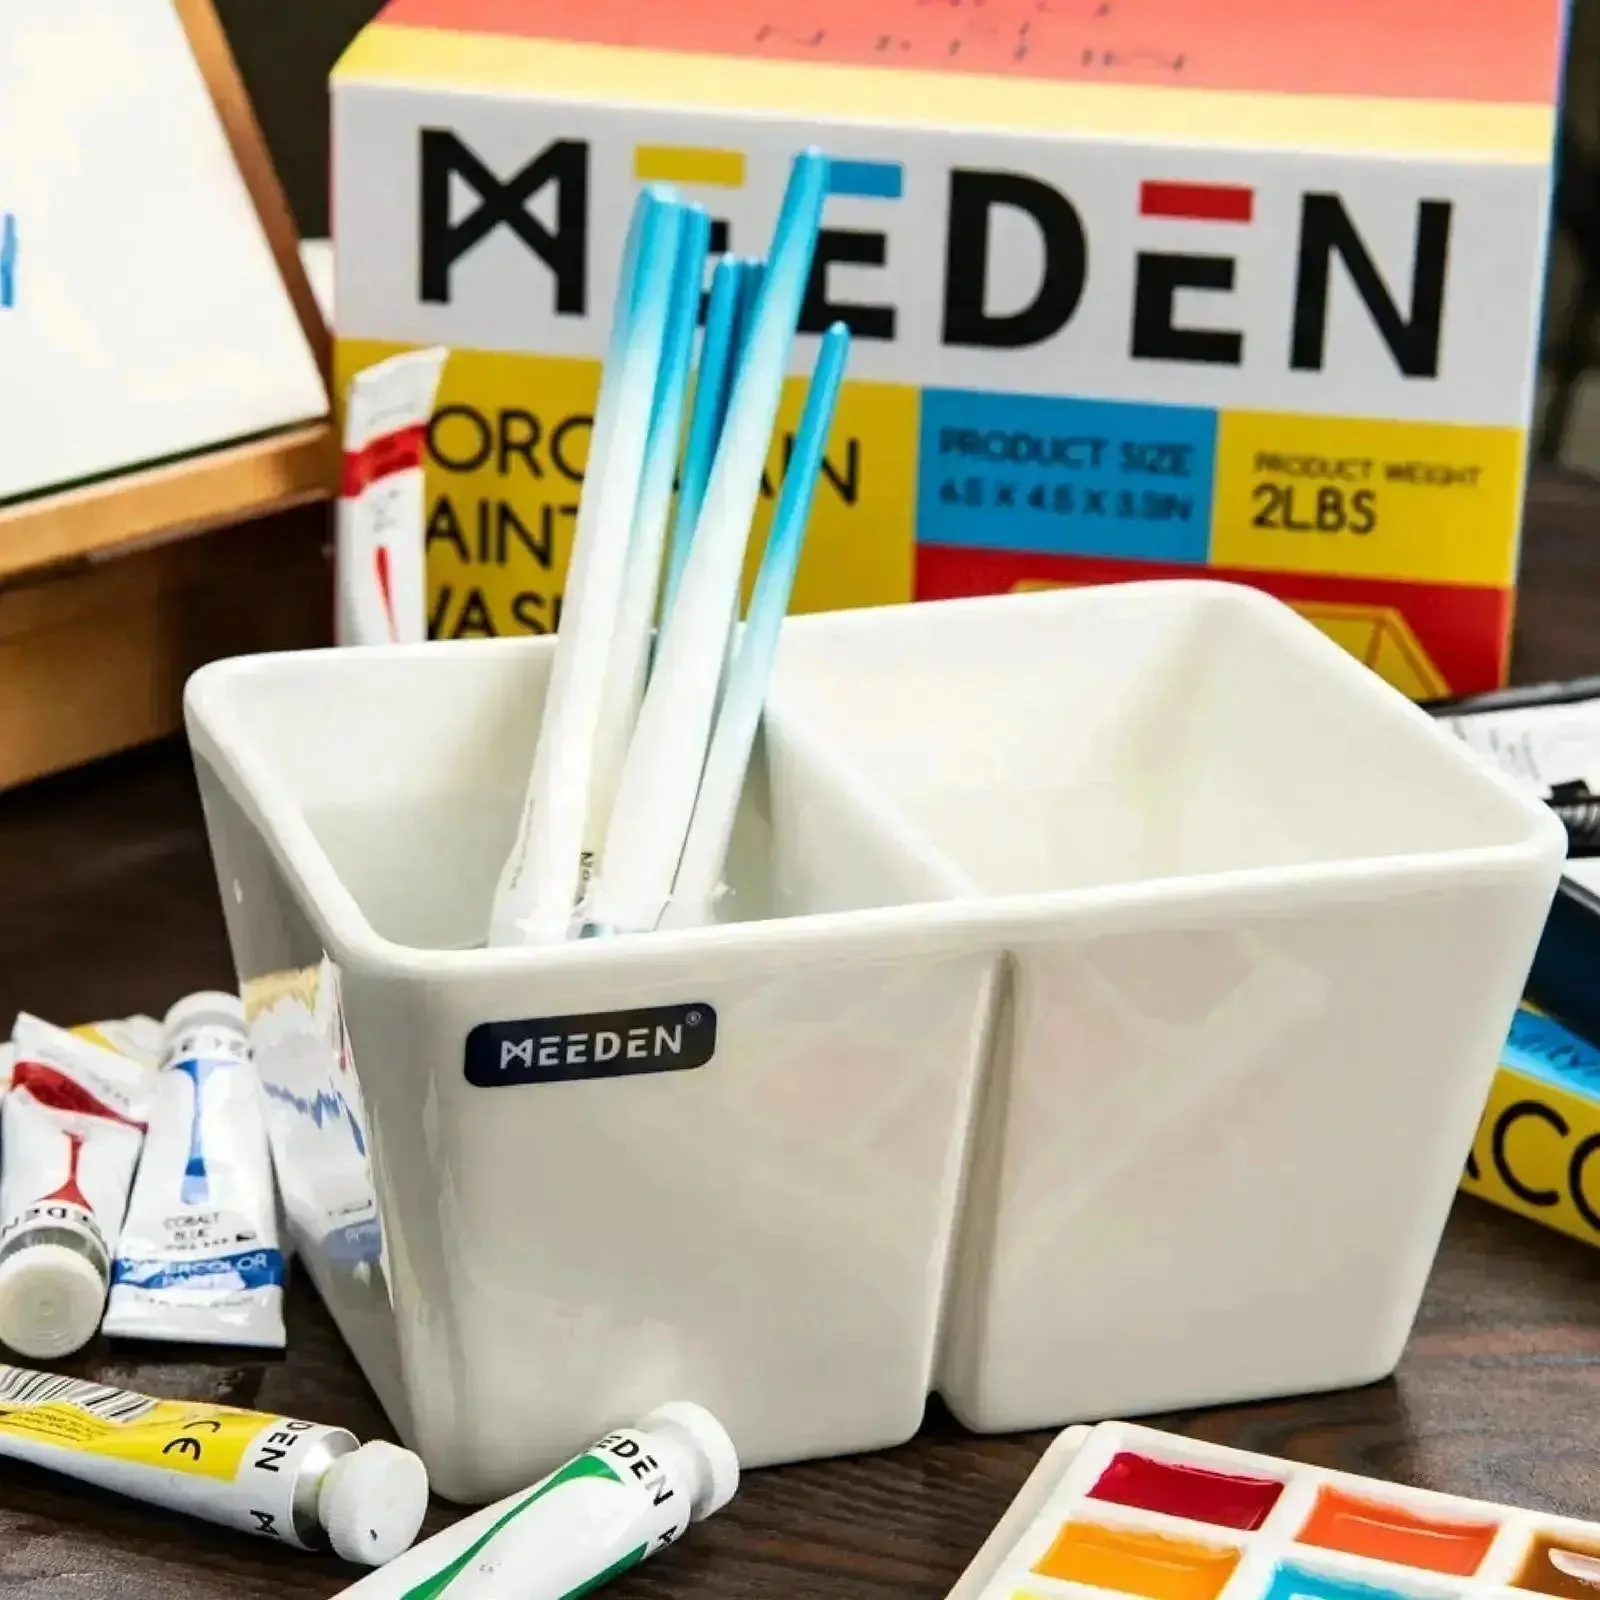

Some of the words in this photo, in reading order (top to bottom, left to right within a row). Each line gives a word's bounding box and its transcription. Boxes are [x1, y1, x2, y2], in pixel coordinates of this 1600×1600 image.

[939, 425, 1107, 470] PRODUCT
[1120, 440, 1194, 477] SIZE
[1253, 451, 1372, 481] PRODUCT
[1383, 461, 1481, 486] WEIGHT
[1252, 482, 1377, 535] 2LBS
[500, 1024, 682, 1069] MEEDEN
